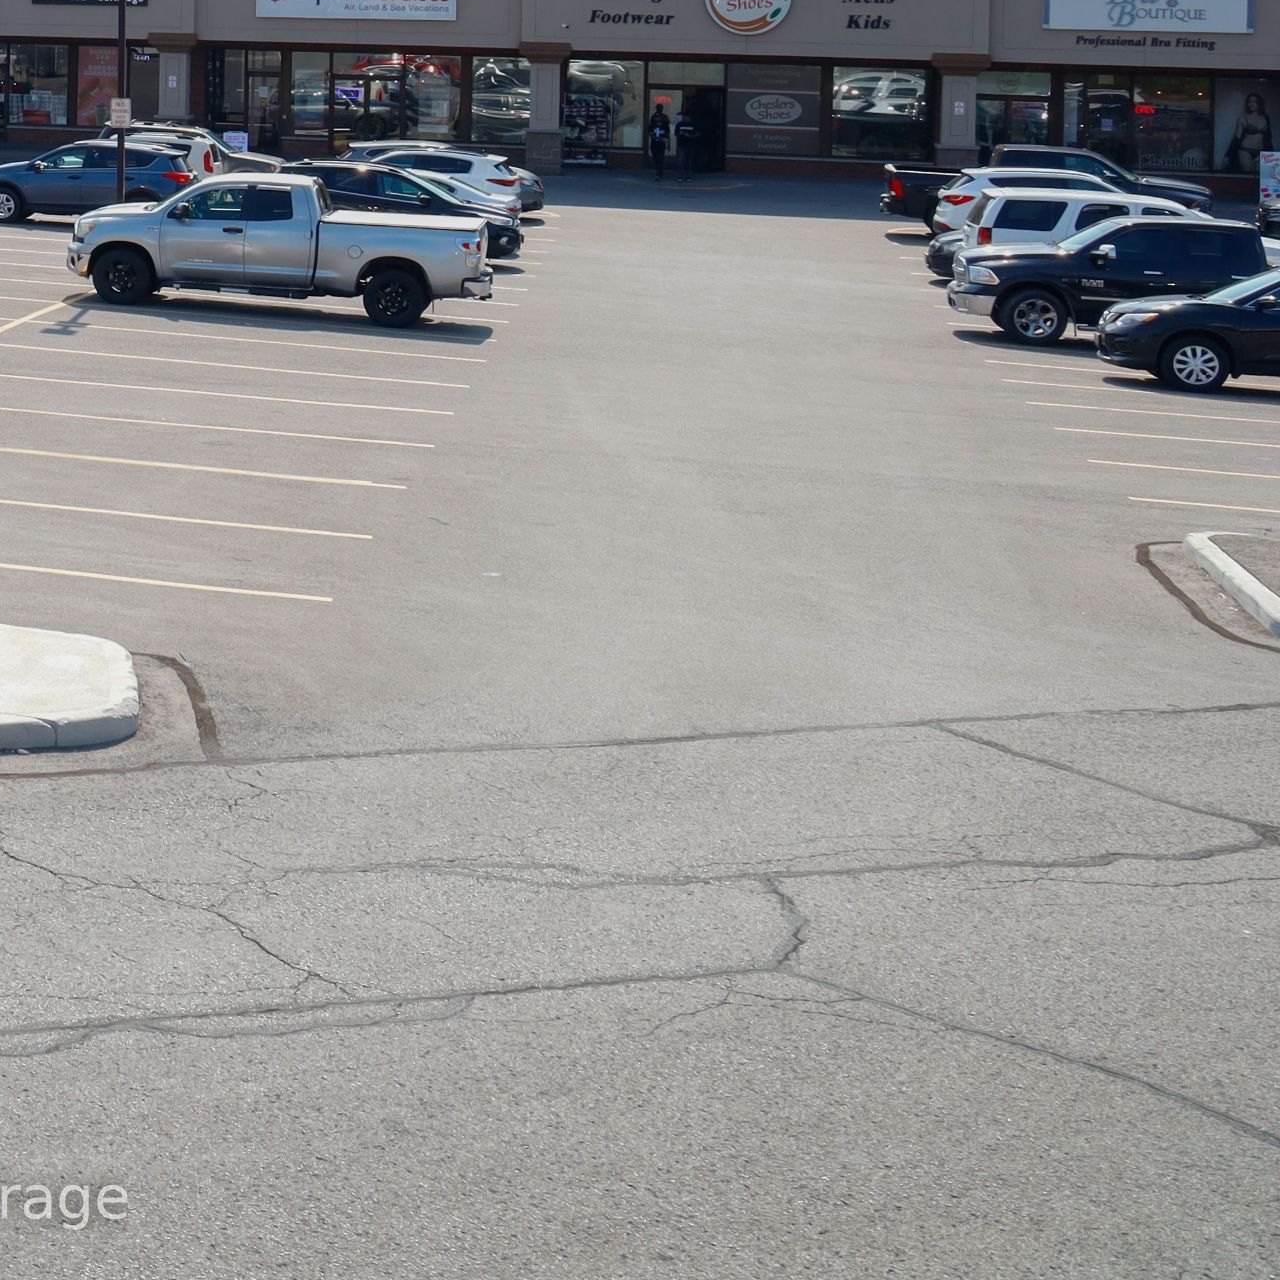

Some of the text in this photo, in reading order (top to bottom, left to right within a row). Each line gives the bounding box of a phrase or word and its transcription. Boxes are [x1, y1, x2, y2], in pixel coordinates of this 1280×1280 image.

[343, 3, 357, 13] Air,
[358, 4, 379, 12] Land
[390, 5, 406, 13] Sea
[408, 5, 449, 13] Vacations
[589, 10, 674, 26] Footwear
[845, 15, 891, 30] Kids
[1075, 35, 1216, 51] Professional Bra Fitting
[756, 109, 792, 120] Shoes
